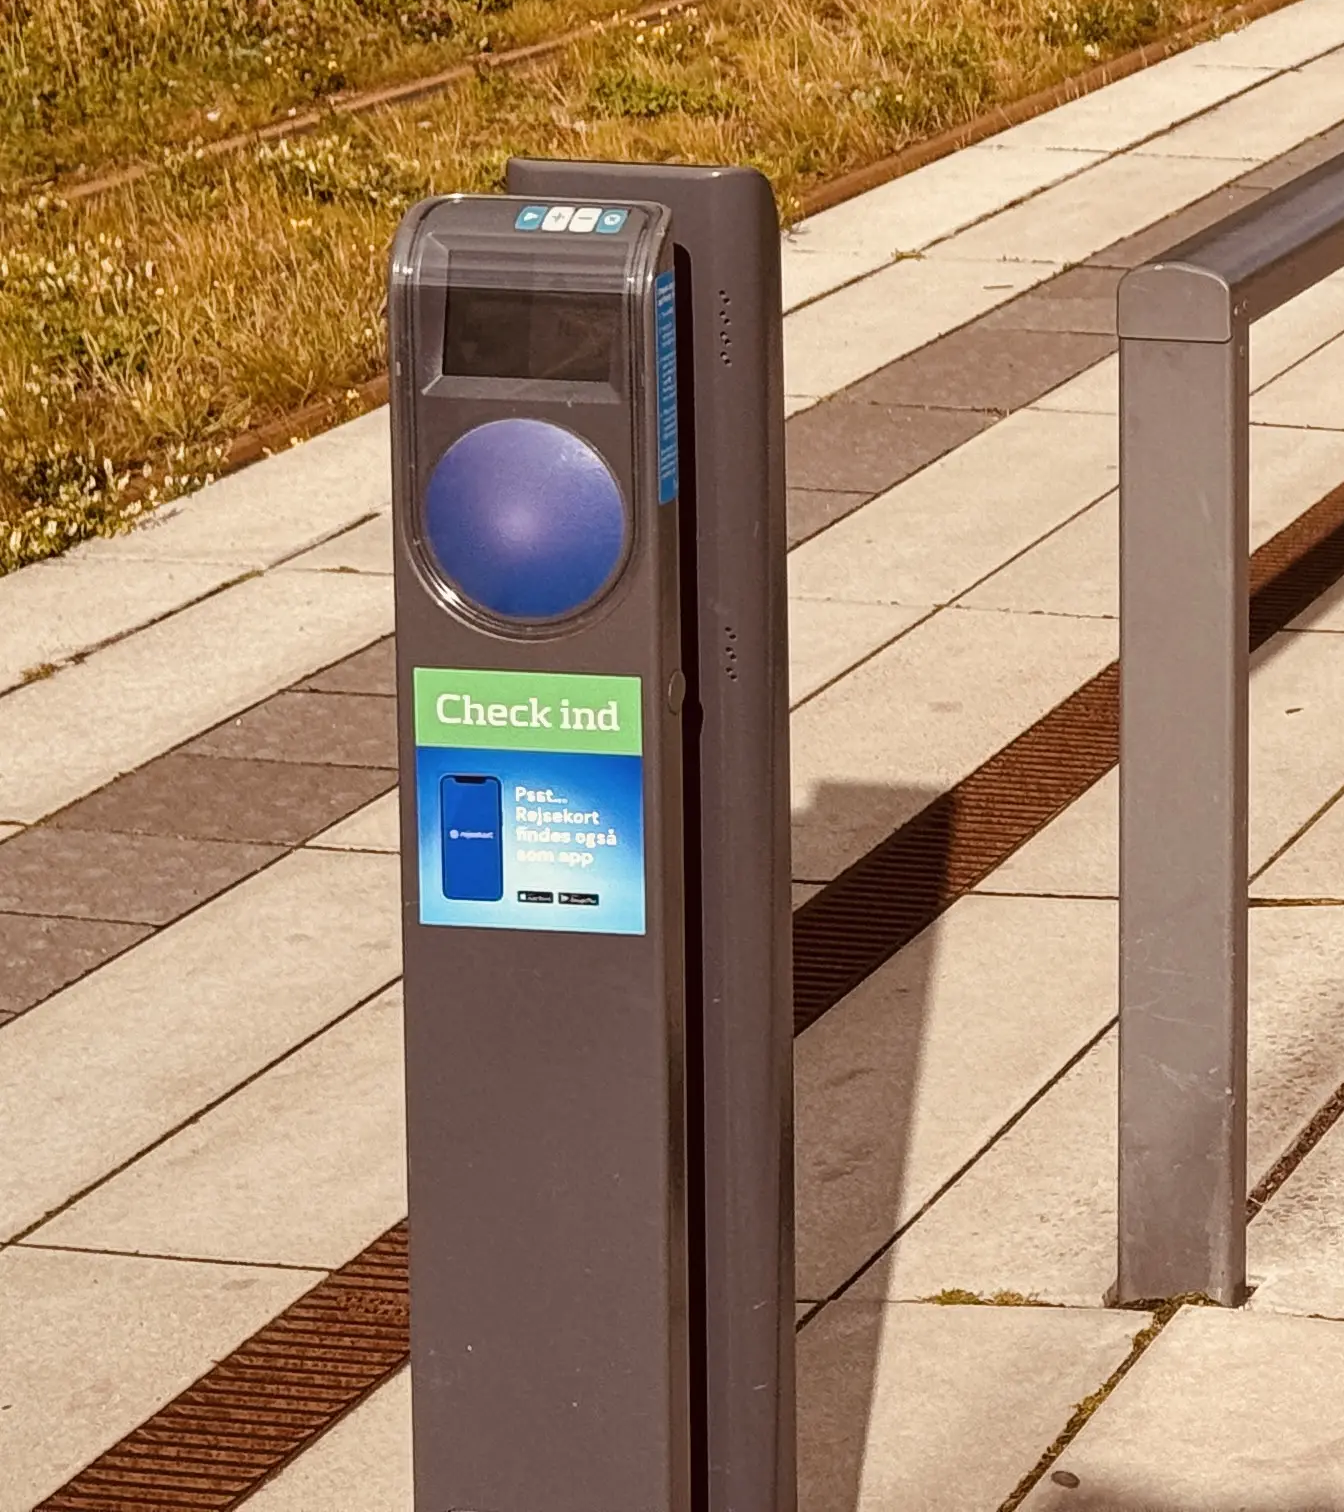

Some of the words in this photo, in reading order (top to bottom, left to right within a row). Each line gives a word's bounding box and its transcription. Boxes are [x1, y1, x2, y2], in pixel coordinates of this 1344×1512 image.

[436, 693, 552, 728] Check
[559, 698, 621, 732] ind
[515, 806, 600, 826] Rejsekort
[515, 825, 571, 844] findes
[574, 828, 617, 848] også
[558, 851, 594, 868] app
